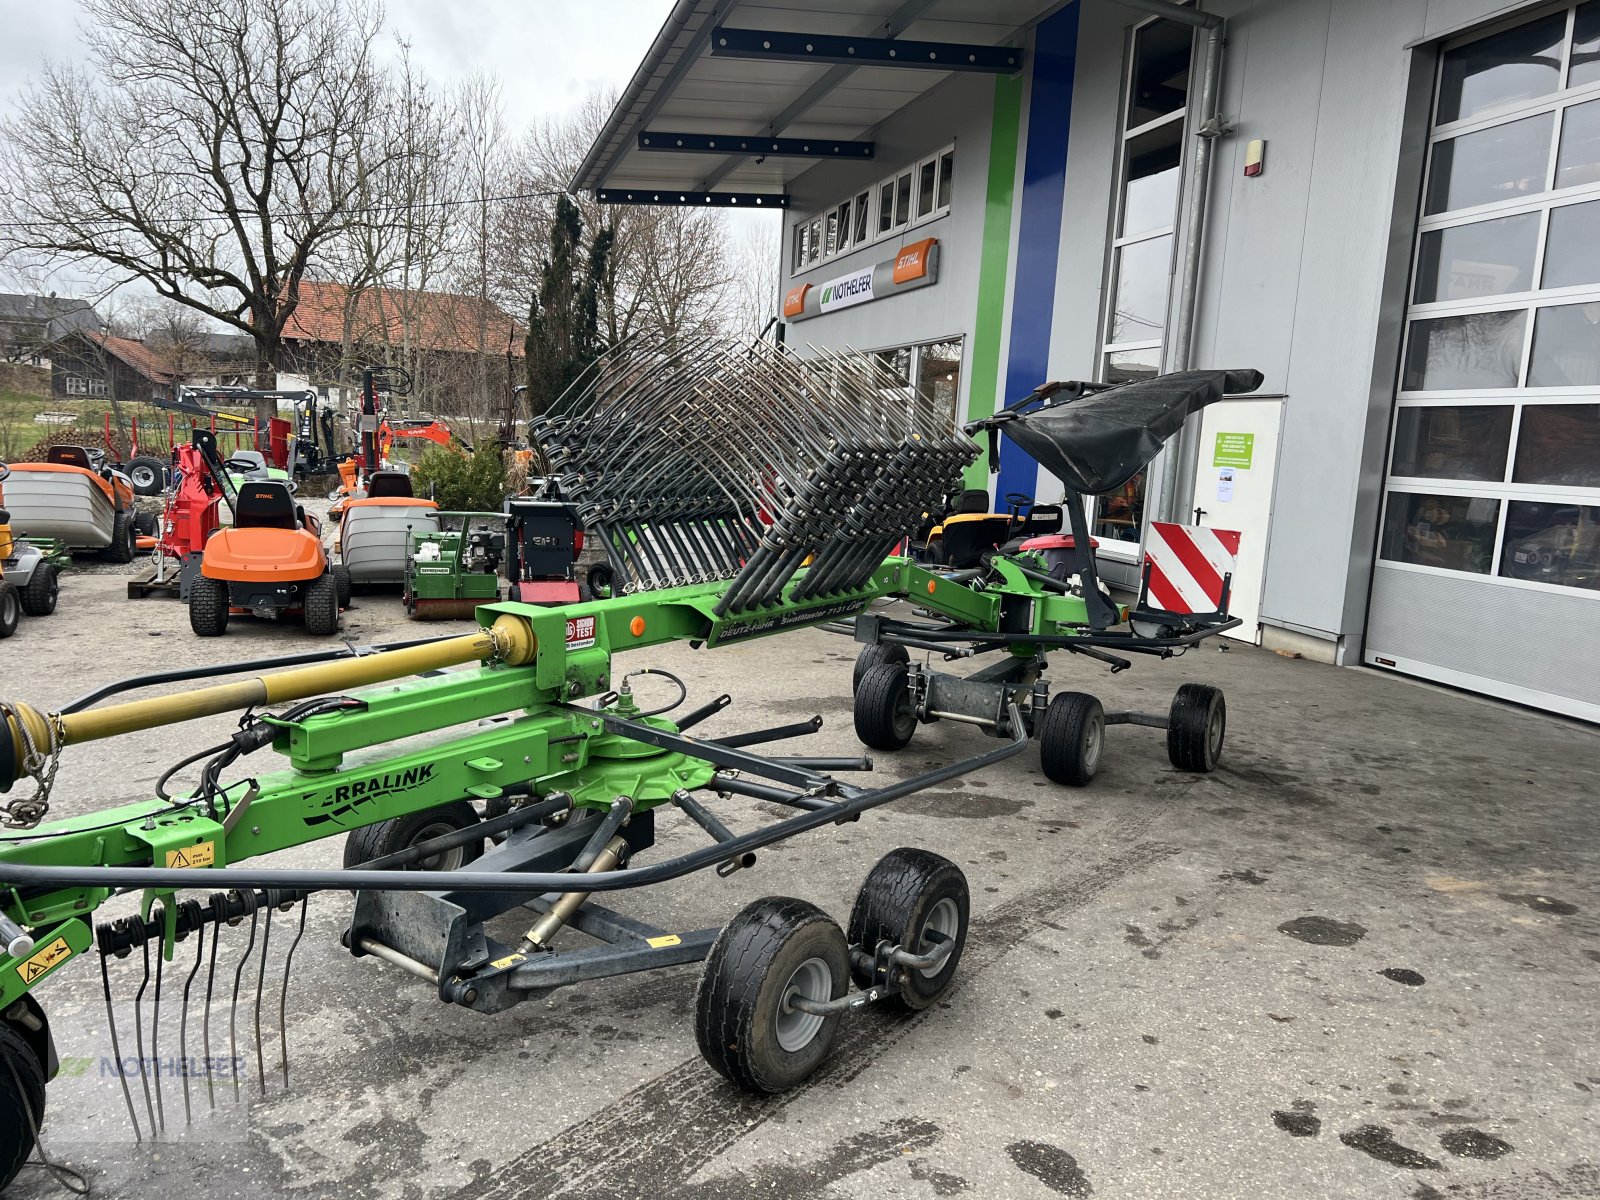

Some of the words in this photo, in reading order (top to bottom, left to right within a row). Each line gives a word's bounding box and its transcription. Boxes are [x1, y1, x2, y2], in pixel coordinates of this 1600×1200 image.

[898, 252, 919, 269] STIHL
[832, 274, 872, 301] NOTHELFER
[576, 626, 594, 639] TEST
[719, 620, 775, 639] DEUTZ-FAHR
[781, 610, 827, 626] SwatMaster
[827, 605, 846, 616] 7131
[303, 763, 434, 808] RRALINK
